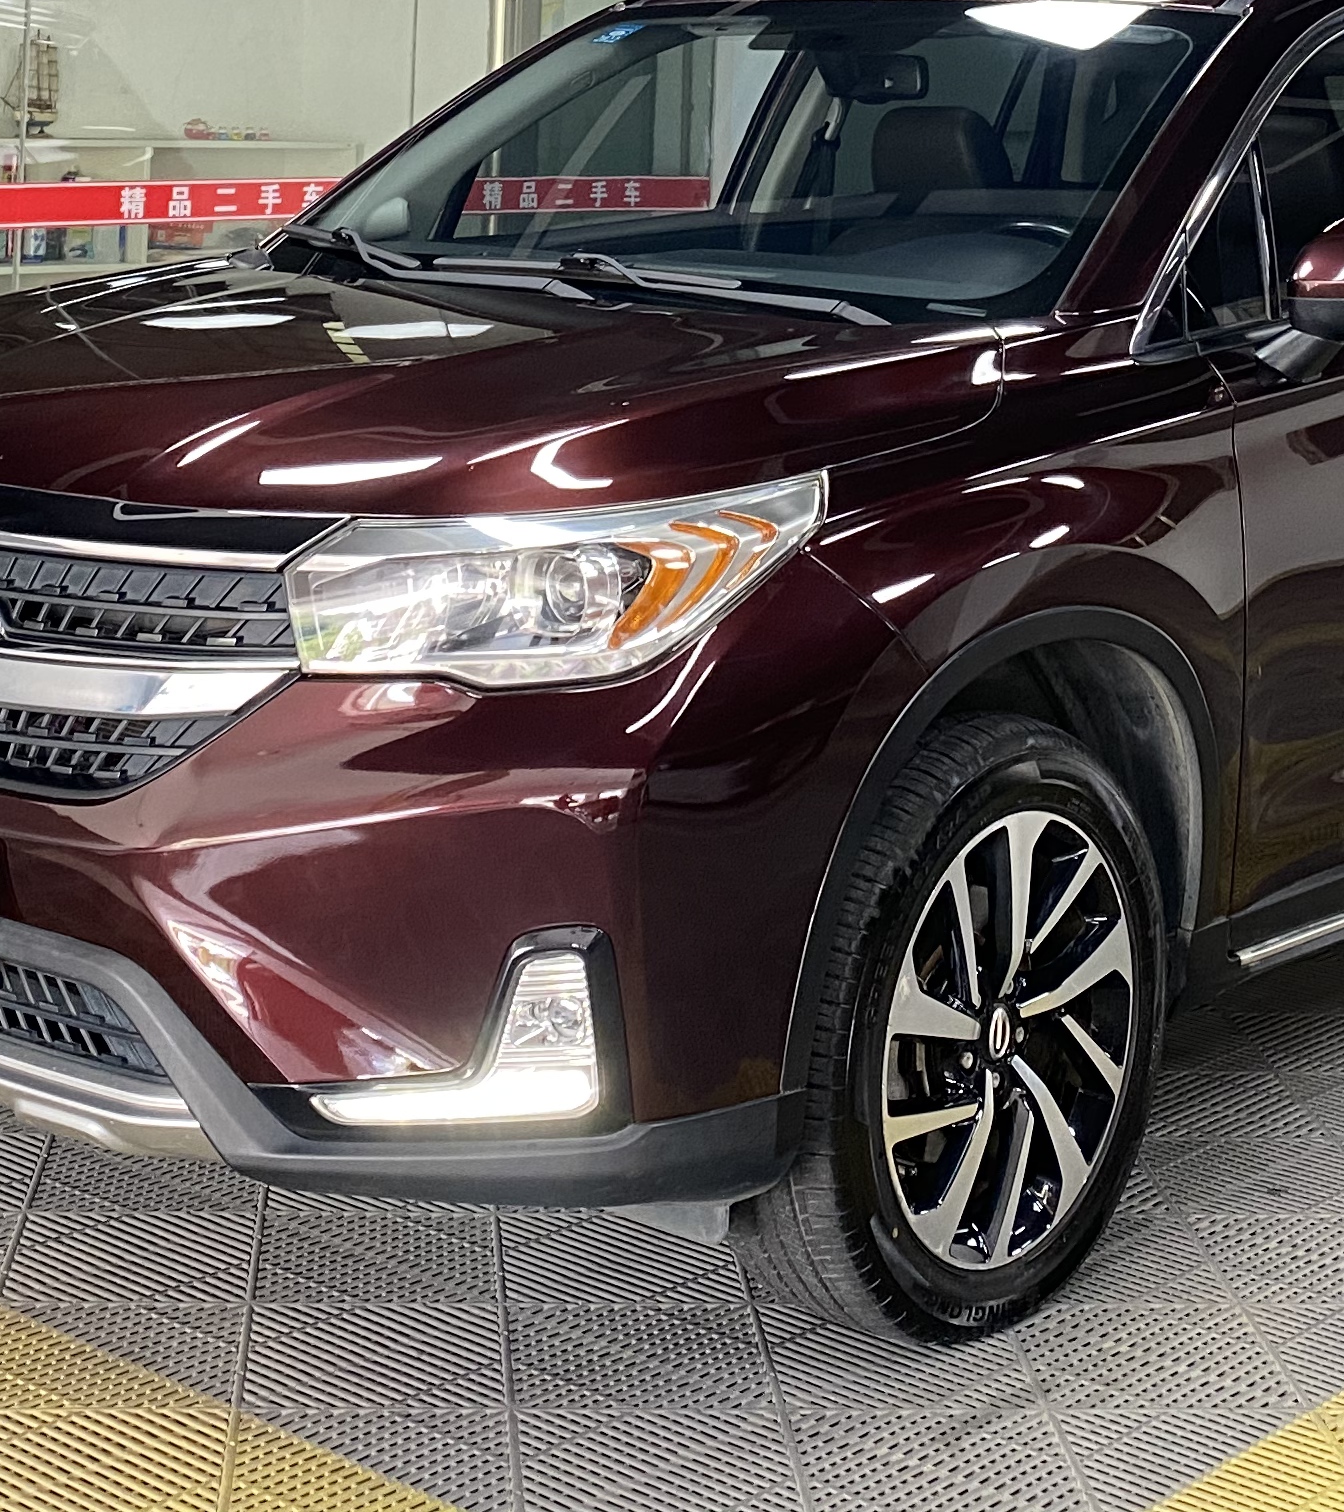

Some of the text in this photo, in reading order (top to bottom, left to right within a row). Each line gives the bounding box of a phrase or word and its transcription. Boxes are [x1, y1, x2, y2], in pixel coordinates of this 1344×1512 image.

[483, 180, 641, 210] 精品二手车
